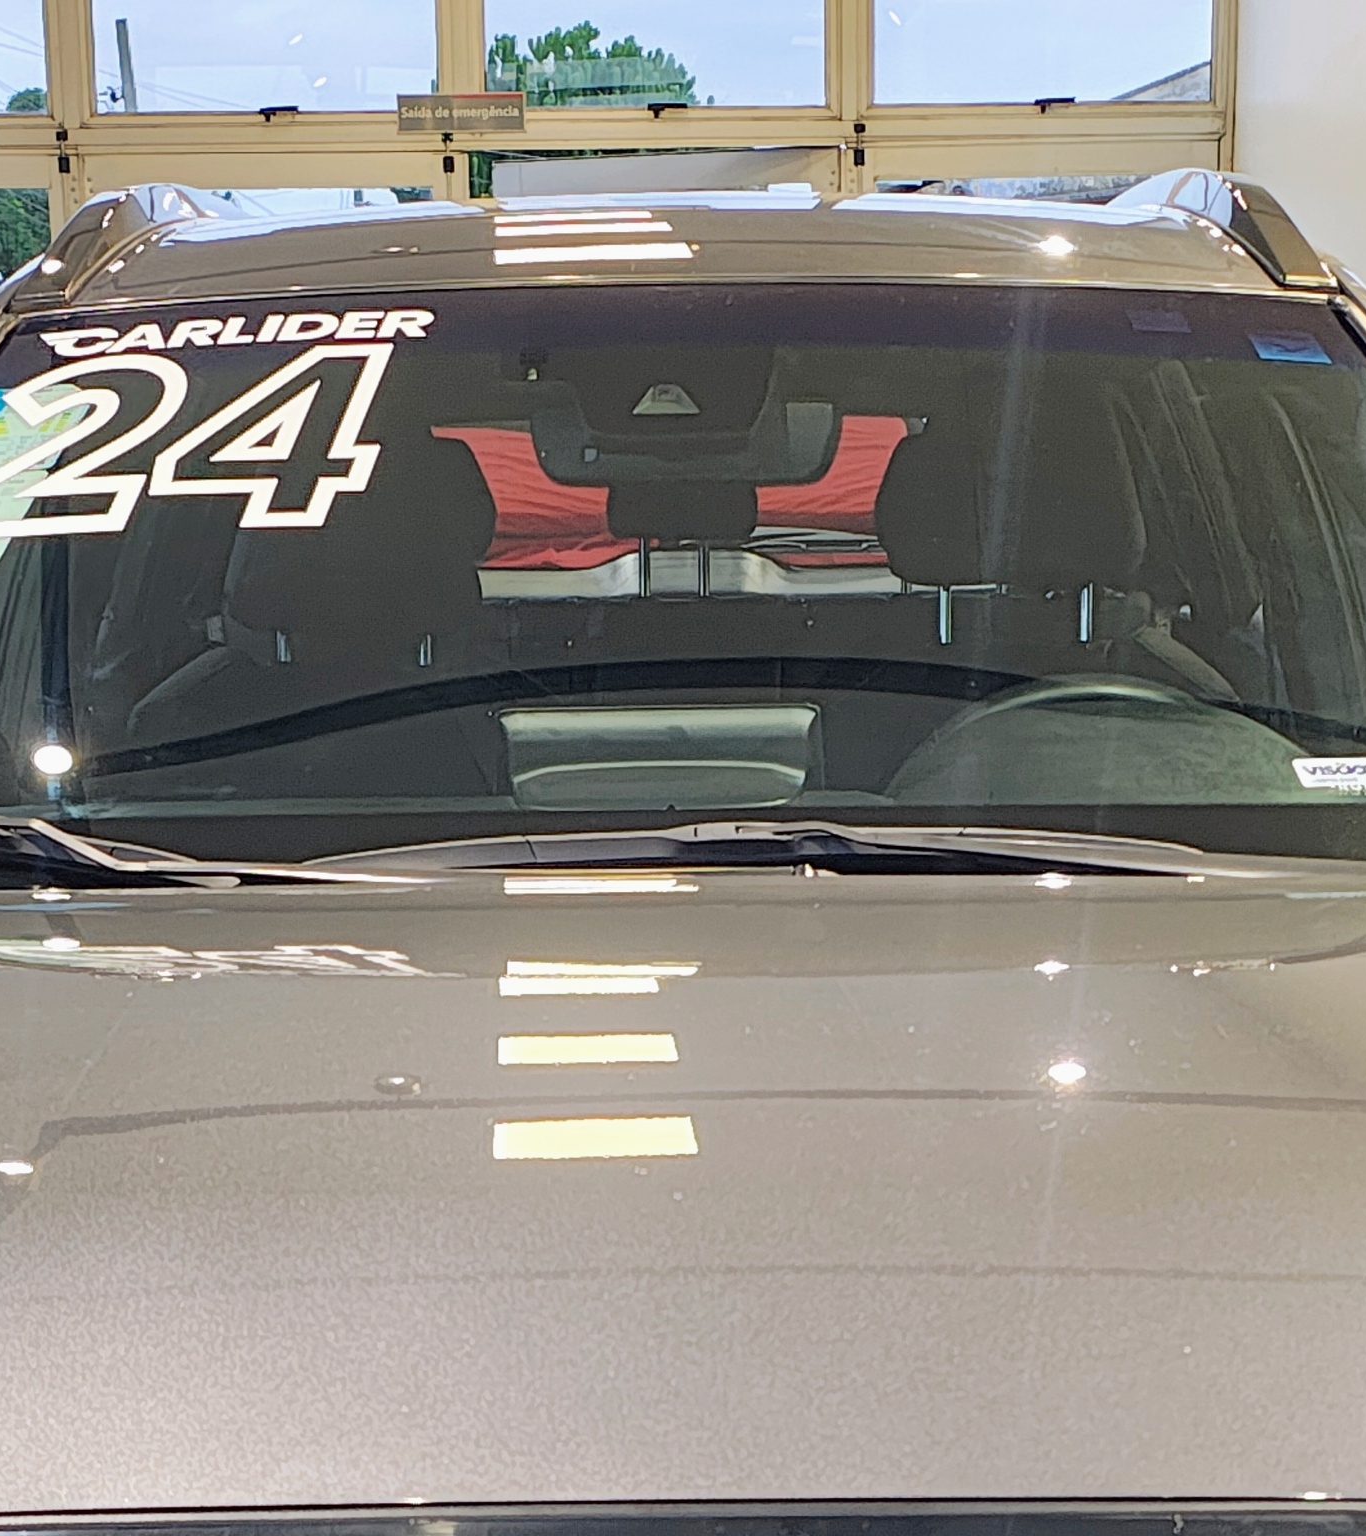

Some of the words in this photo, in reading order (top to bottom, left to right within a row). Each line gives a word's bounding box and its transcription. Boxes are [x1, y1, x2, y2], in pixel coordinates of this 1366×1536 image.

[400, 105, 432, 119] Saída
[434, 105, 450, 119] de
[452, 105, 520, 120] emergência
[39, 309, 435, 358] CARLIDER
